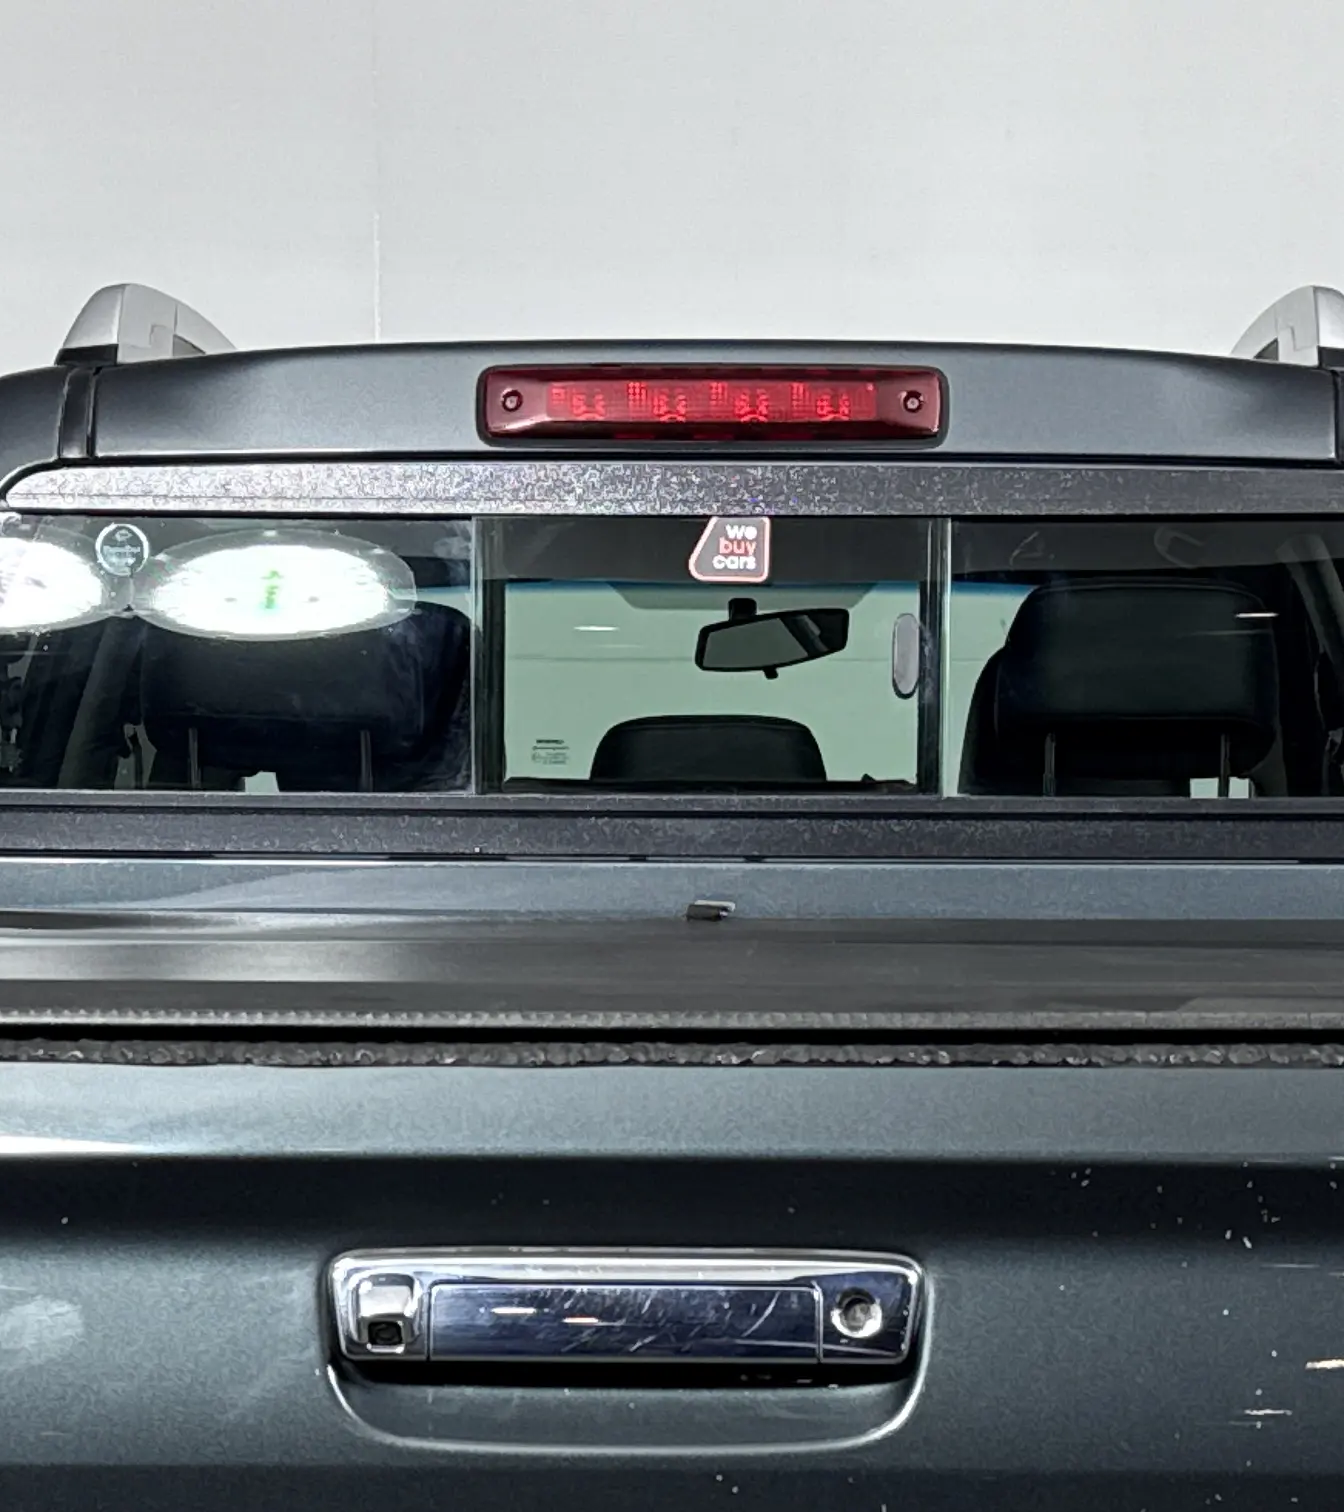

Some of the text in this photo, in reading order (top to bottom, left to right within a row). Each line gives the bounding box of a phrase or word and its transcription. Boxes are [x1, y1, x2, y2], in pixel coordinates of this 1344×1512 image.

[725, 524, 757, 540] we
[719, 537, 756, 556] buy
[712, 554, 756, 570] cars
